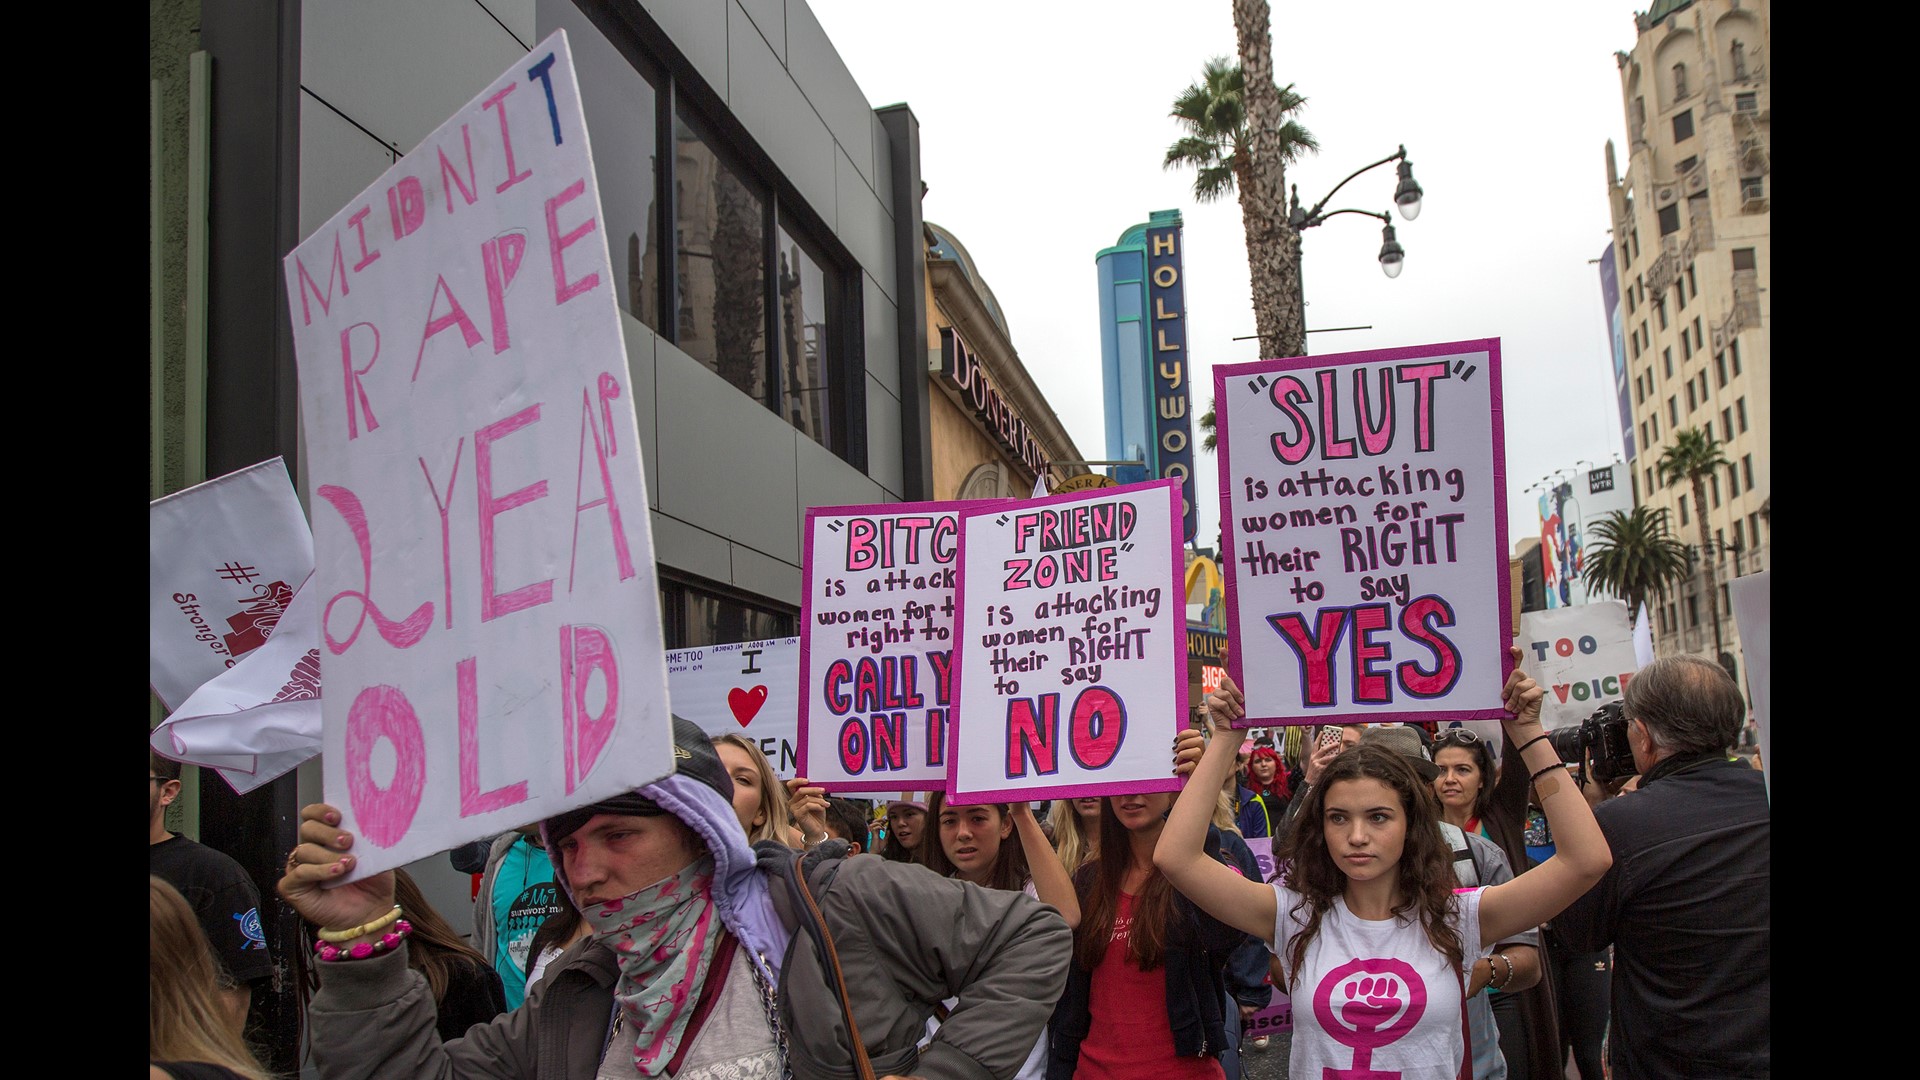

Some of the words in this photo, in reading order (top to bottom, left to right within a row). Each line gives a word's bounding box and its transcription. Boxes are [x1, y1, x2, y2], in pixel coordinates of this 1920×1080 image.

[340, 178, 600, 440] RAPE
[1243, 476, 1268, 501] is
[1278, 462, 1465, 503] attacking
[1590, 470, 1611, 482] LIFE
[1591, 479, 1612, 491] WTR
[1241, 503, 1357, 533] women
[1373, 499, 1427, 522] for
[827, 515, 957, 571] "BITC
[1241, 540, 1320, 576] their
[1340, 513, 1465, 573] RIGHT
[825, 578, 846, 597] is
[866, 567, 956, 593] attack
[1289, 576, 1324, 603] to
[1360, 574, 1410, 606] say
[817, 607, 895, 626] women
[902, 601, 935, 621] for
[987, 605, 1014, 626] is
[1035, 585, 1161, 620] attacking
[846, 619, 914, 654] right
[919, 617, 949, 641] to
[982, 626, 1065, 648] women
[1081, 616, 1127, 639] for
[1531, 635, 1597, 662] TOO
[741, 650, 762, 674] I
[990, 649, 1049, 674] their
[1068, 628, 1151, 666] RIGHT
[1265, 593, 1463, 708] YES
[824, 655, 924, 716] CALL
[994, 676, 1019, 695] to
[1060, 664, 1101, 686] say
[838, 711, 907, 775] ON
[1005, 685, 1128, 780] NO
[1247, 1009, 1291, 1030] asci
